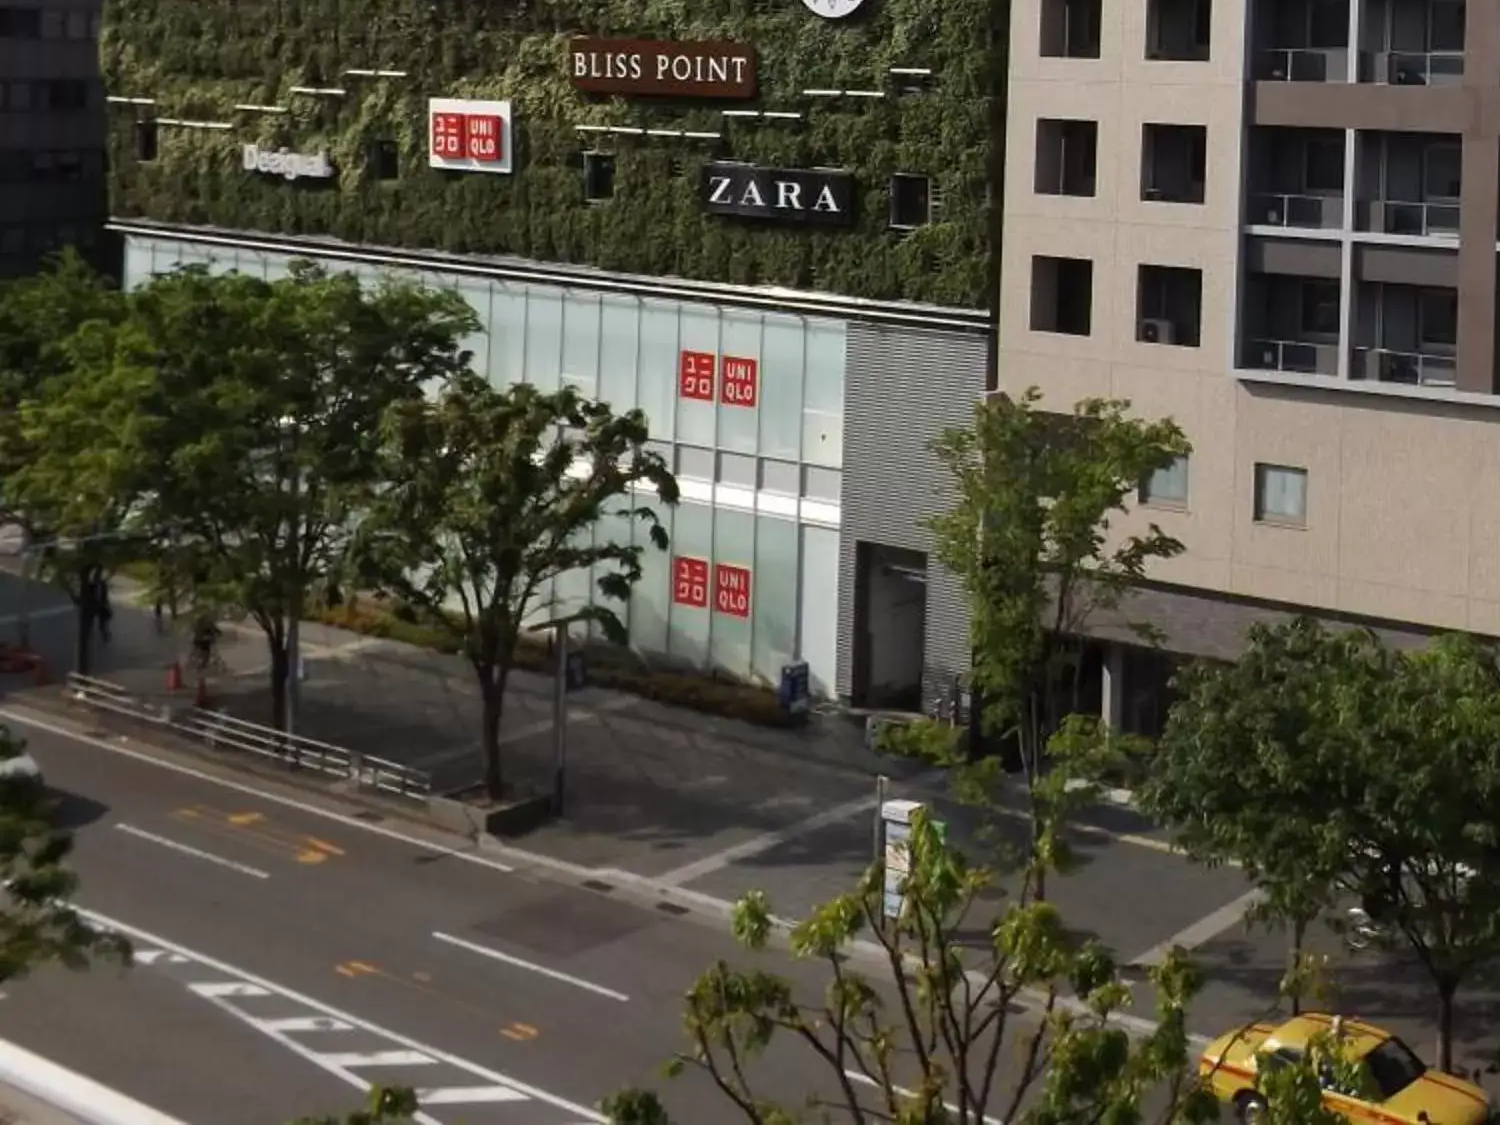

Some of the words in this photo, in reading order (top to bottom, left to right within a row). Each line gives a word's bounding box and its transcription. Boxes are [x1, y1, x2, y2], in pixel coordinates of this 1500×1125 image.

[573, 52, 642, 80] BLISS
[655, 54, 748, 83] POINT
[708, 176, 841, 212] ZARA
